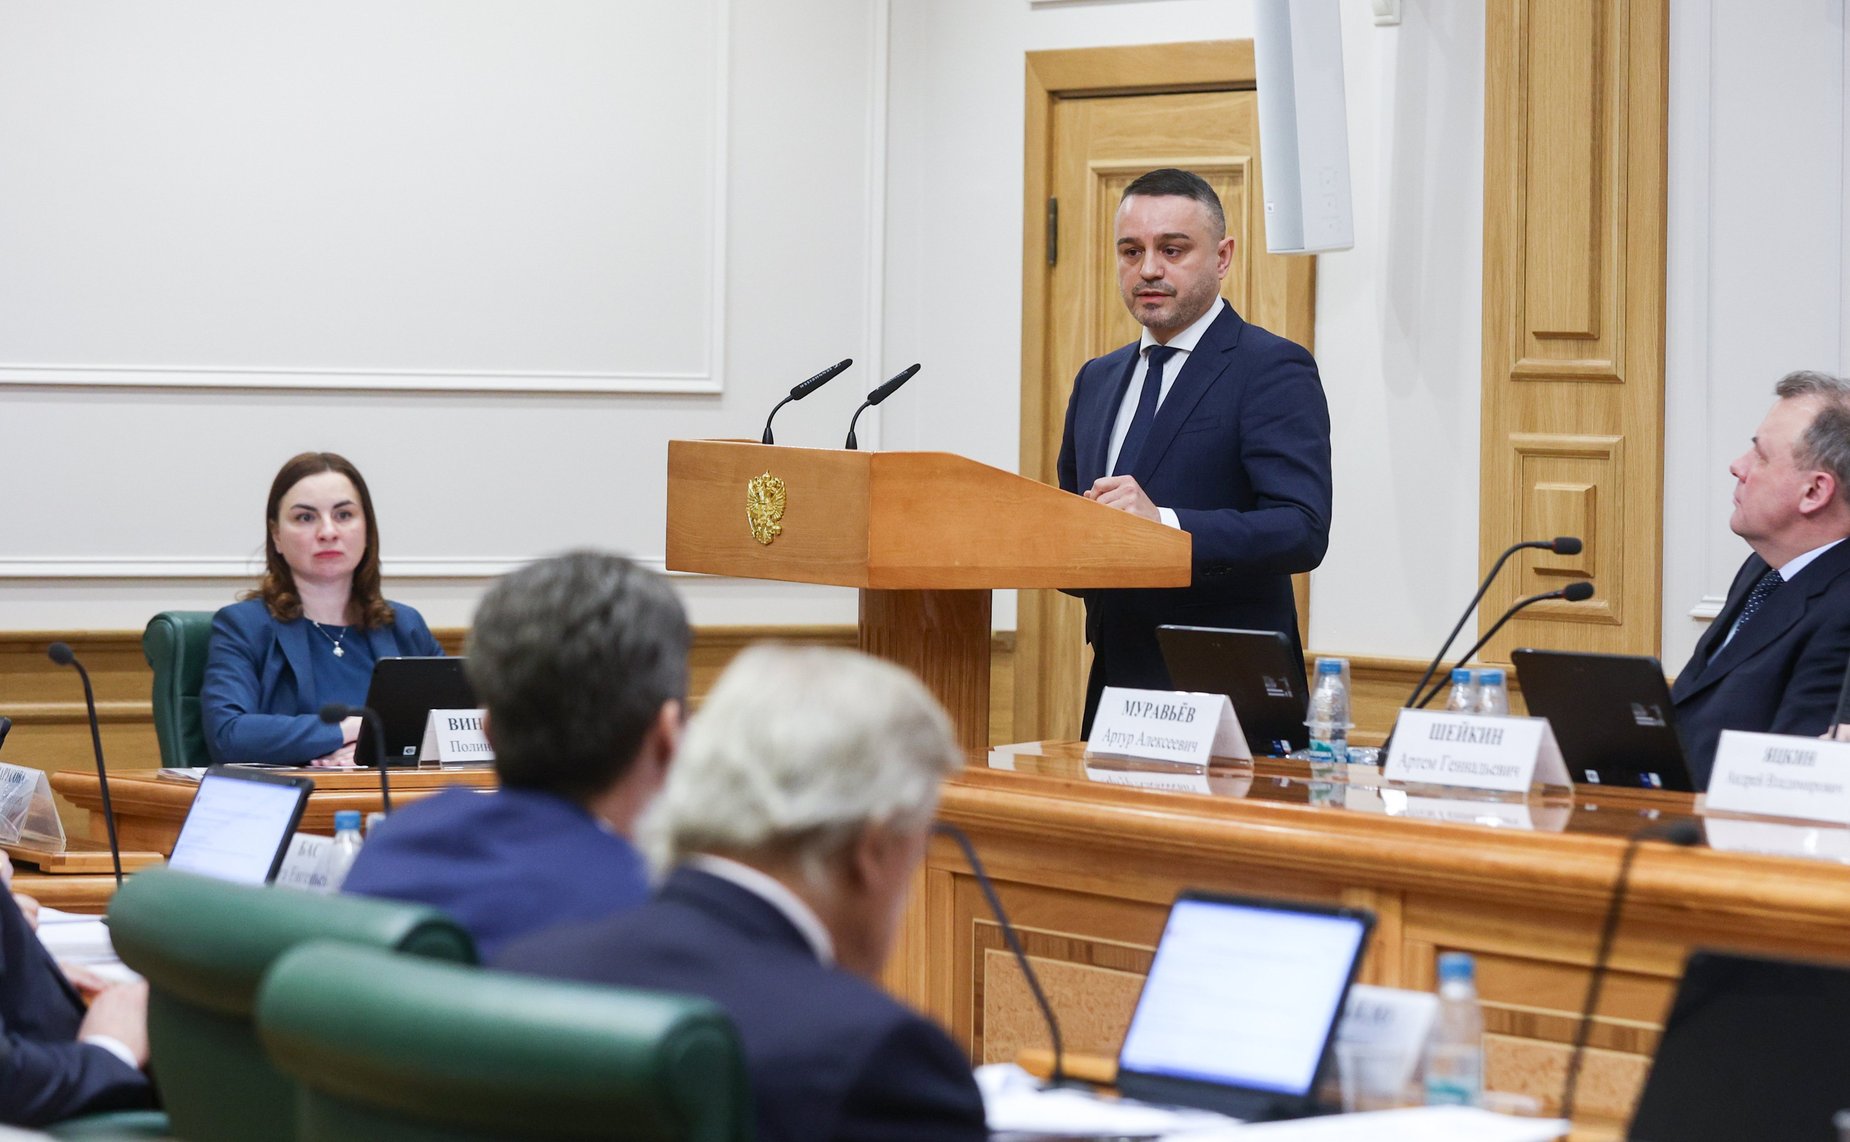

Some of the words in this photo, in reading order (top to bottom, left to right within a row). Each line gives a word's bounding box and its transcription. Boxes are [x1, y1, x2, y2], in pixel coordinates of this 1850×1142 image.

[1122, 700, 1197, 723] МУРАВЬЁВ
[448, 717, 483, 731] ВИН
[1428, 721, 1505, 746] ШЕЙКИН
[1102, 728, 1135, 749] Артур
[1135, 731, 1199, 753] Алексеевич
